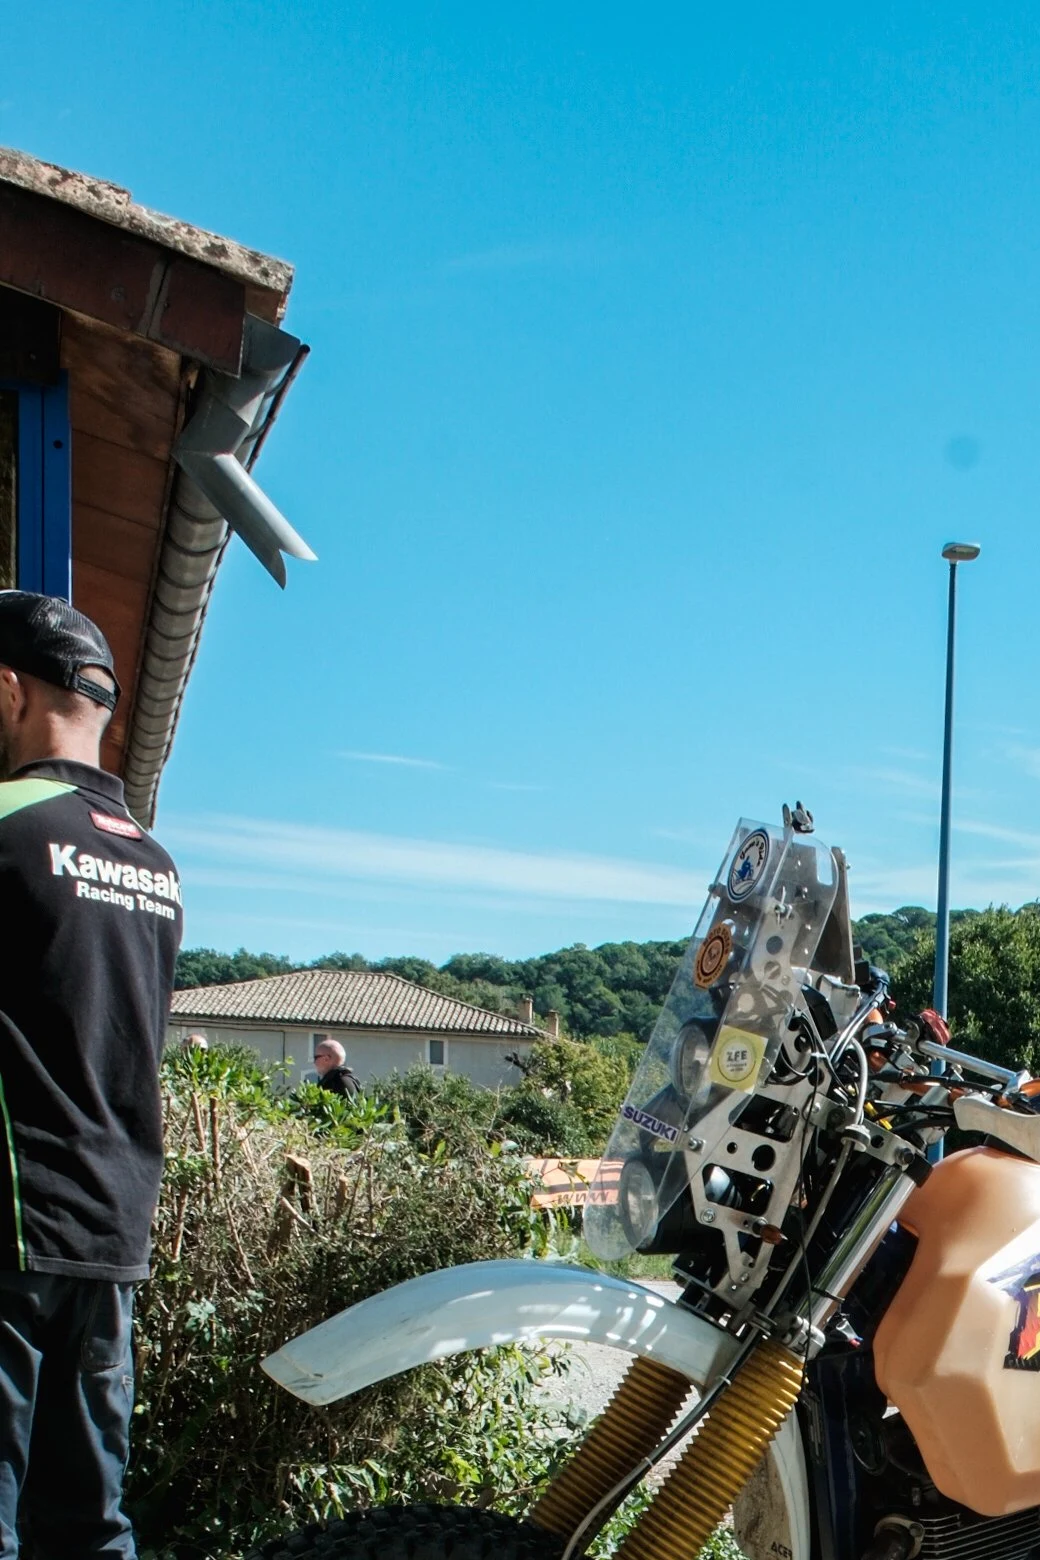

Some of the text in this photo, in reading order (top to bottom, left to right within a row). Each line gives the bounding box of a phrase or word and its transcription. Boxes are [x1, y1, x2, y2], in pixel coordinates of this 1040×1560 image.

[76, 881, 175, 920] Racing Team
[623, 1105, 678, 1141] SUZUKI
